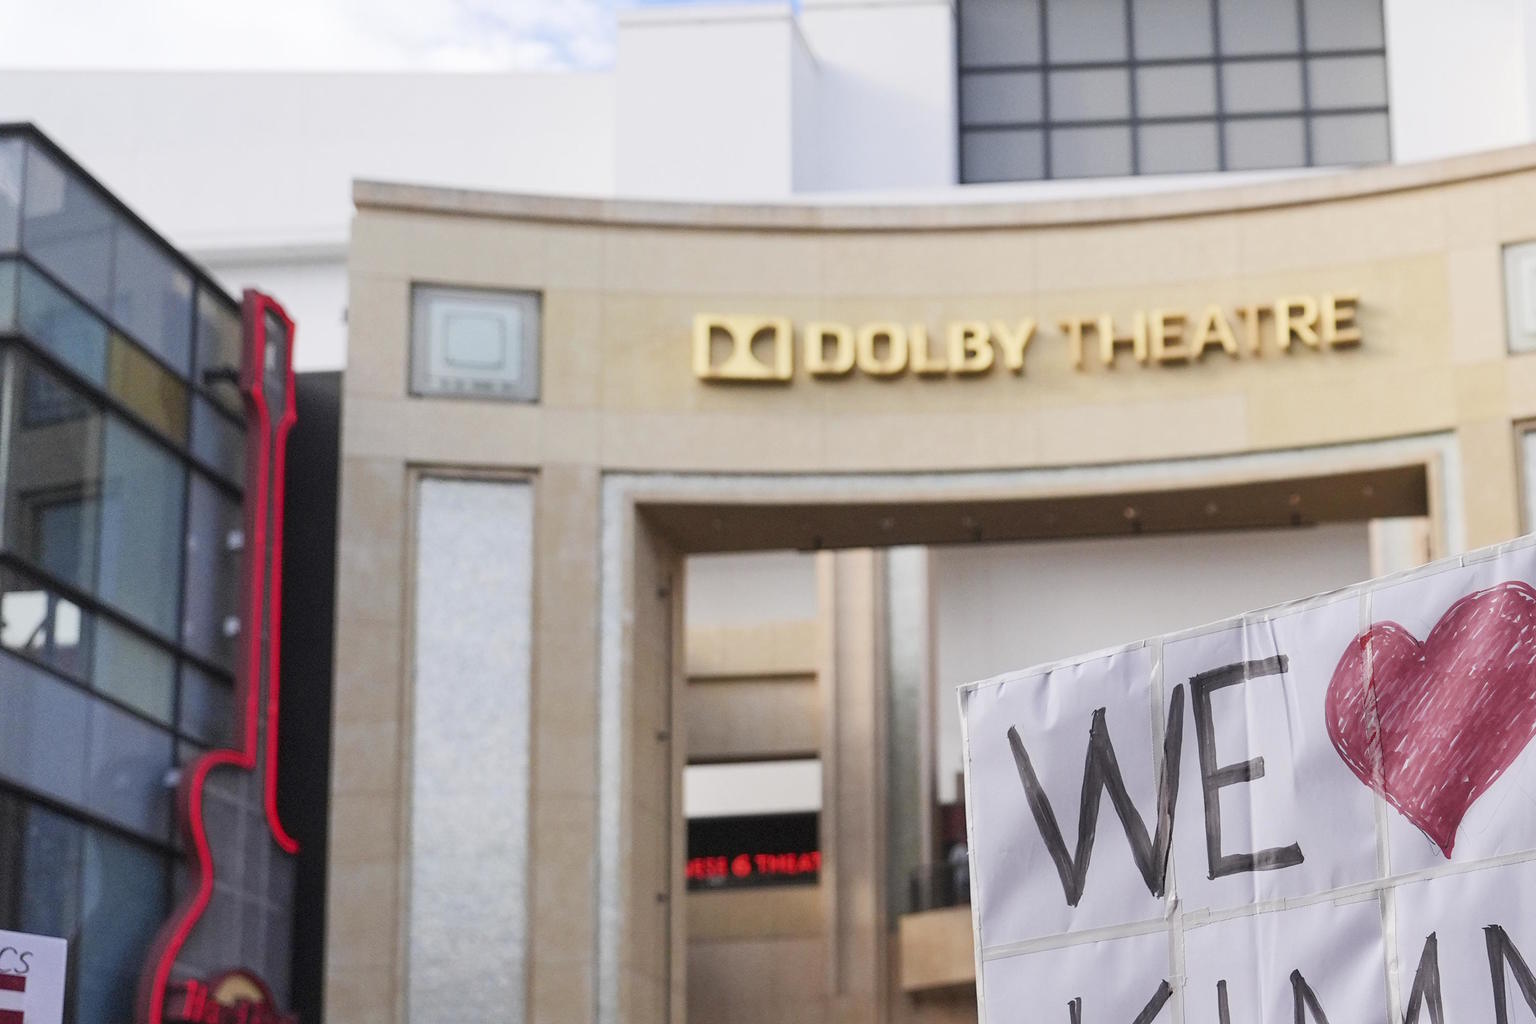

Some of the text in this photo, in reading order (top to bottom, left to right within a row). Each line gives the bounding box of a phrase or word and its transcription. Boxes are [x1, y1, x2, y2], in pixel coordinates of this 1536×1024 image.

[803, 292, 1362, 375] DOLBY THEATRE
[1007, 654, 1304, 907] WE
